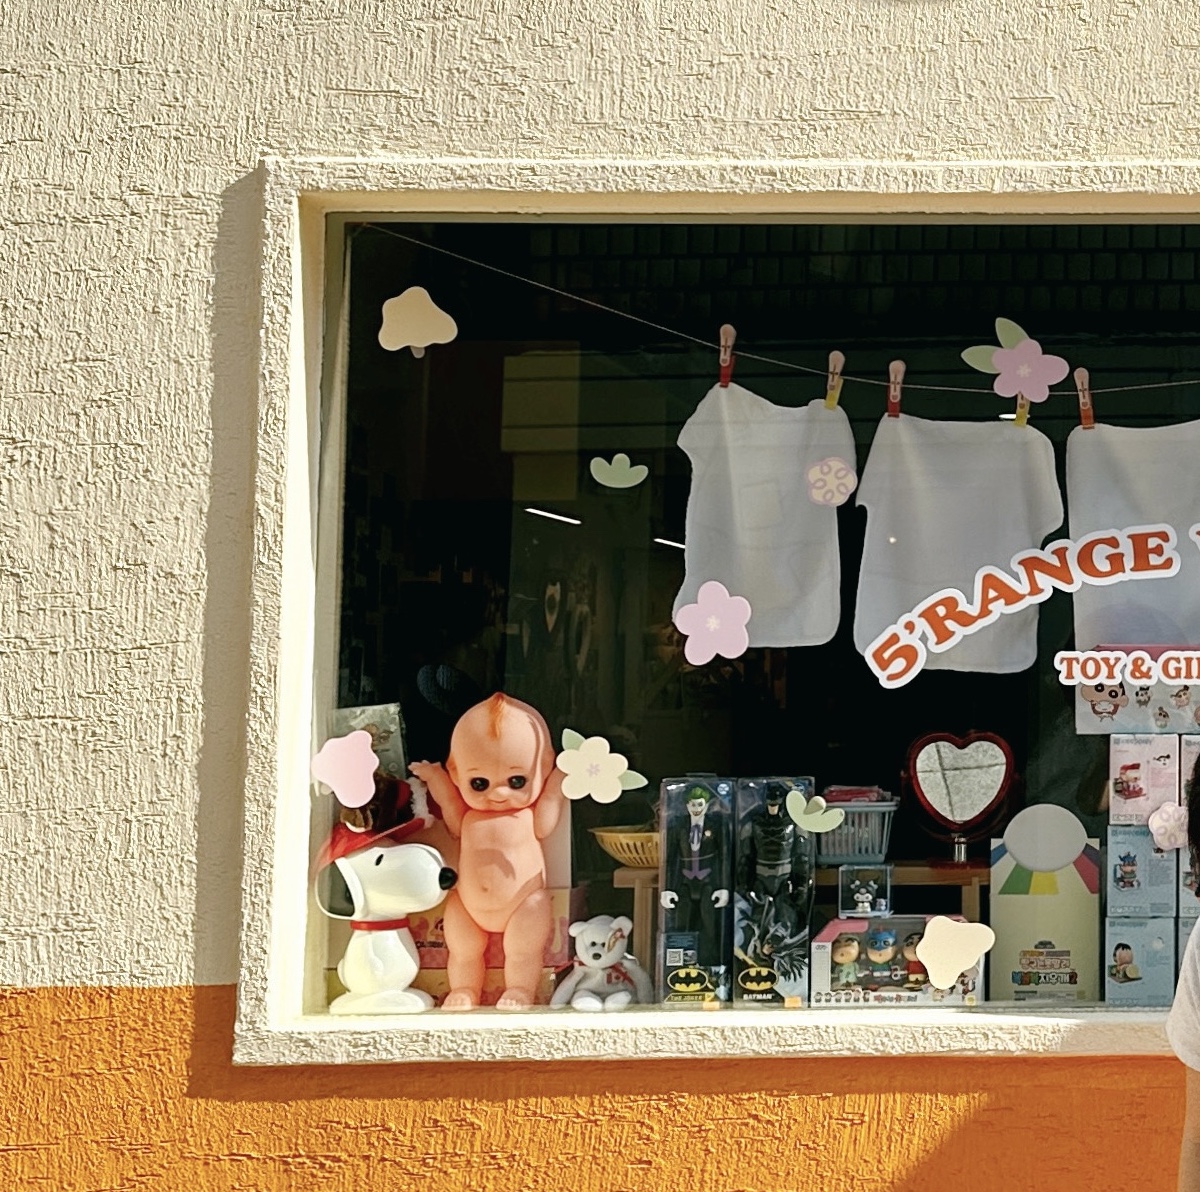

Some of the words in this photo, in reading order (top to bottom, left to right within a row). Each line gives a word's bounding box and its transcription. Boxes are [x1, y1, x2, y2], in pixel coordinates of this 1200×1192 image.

[871, 530, 1174, 682] 5'RANGE
[1059, 656, 1122, 679] TOY
[1129, 656, 1152, 679] &
